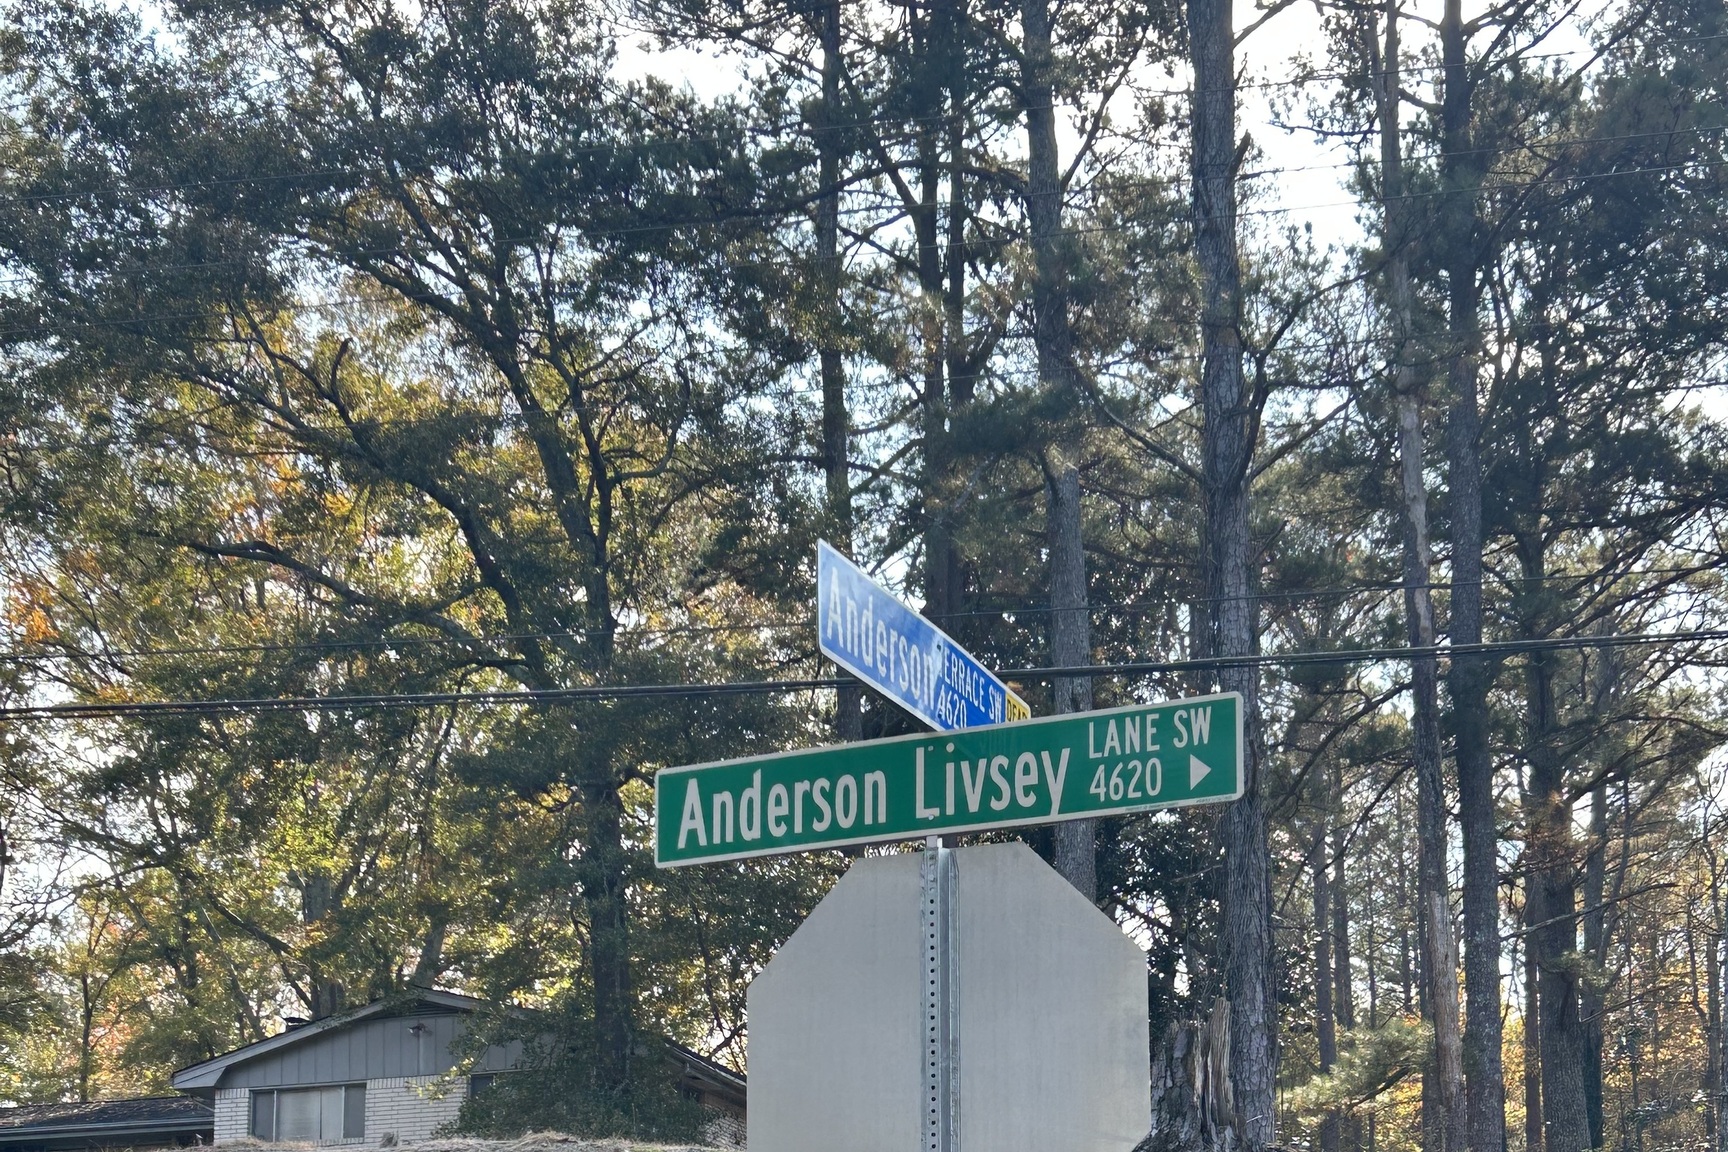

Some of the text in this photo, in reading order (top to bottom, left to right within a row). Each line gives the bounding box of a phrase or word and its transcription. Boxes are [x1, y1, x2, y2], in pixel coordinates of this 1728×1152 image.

[827, 567, 935, 711] Anderson
[936, 684, 967, 729] 4620
[988, 684, 1002, 724] SW
[1089, 706, 1212, 759] LANE SW
[677, 743, 1071, 850] Anderson Livsey
[1089, 757, 1162, 802] 4620
